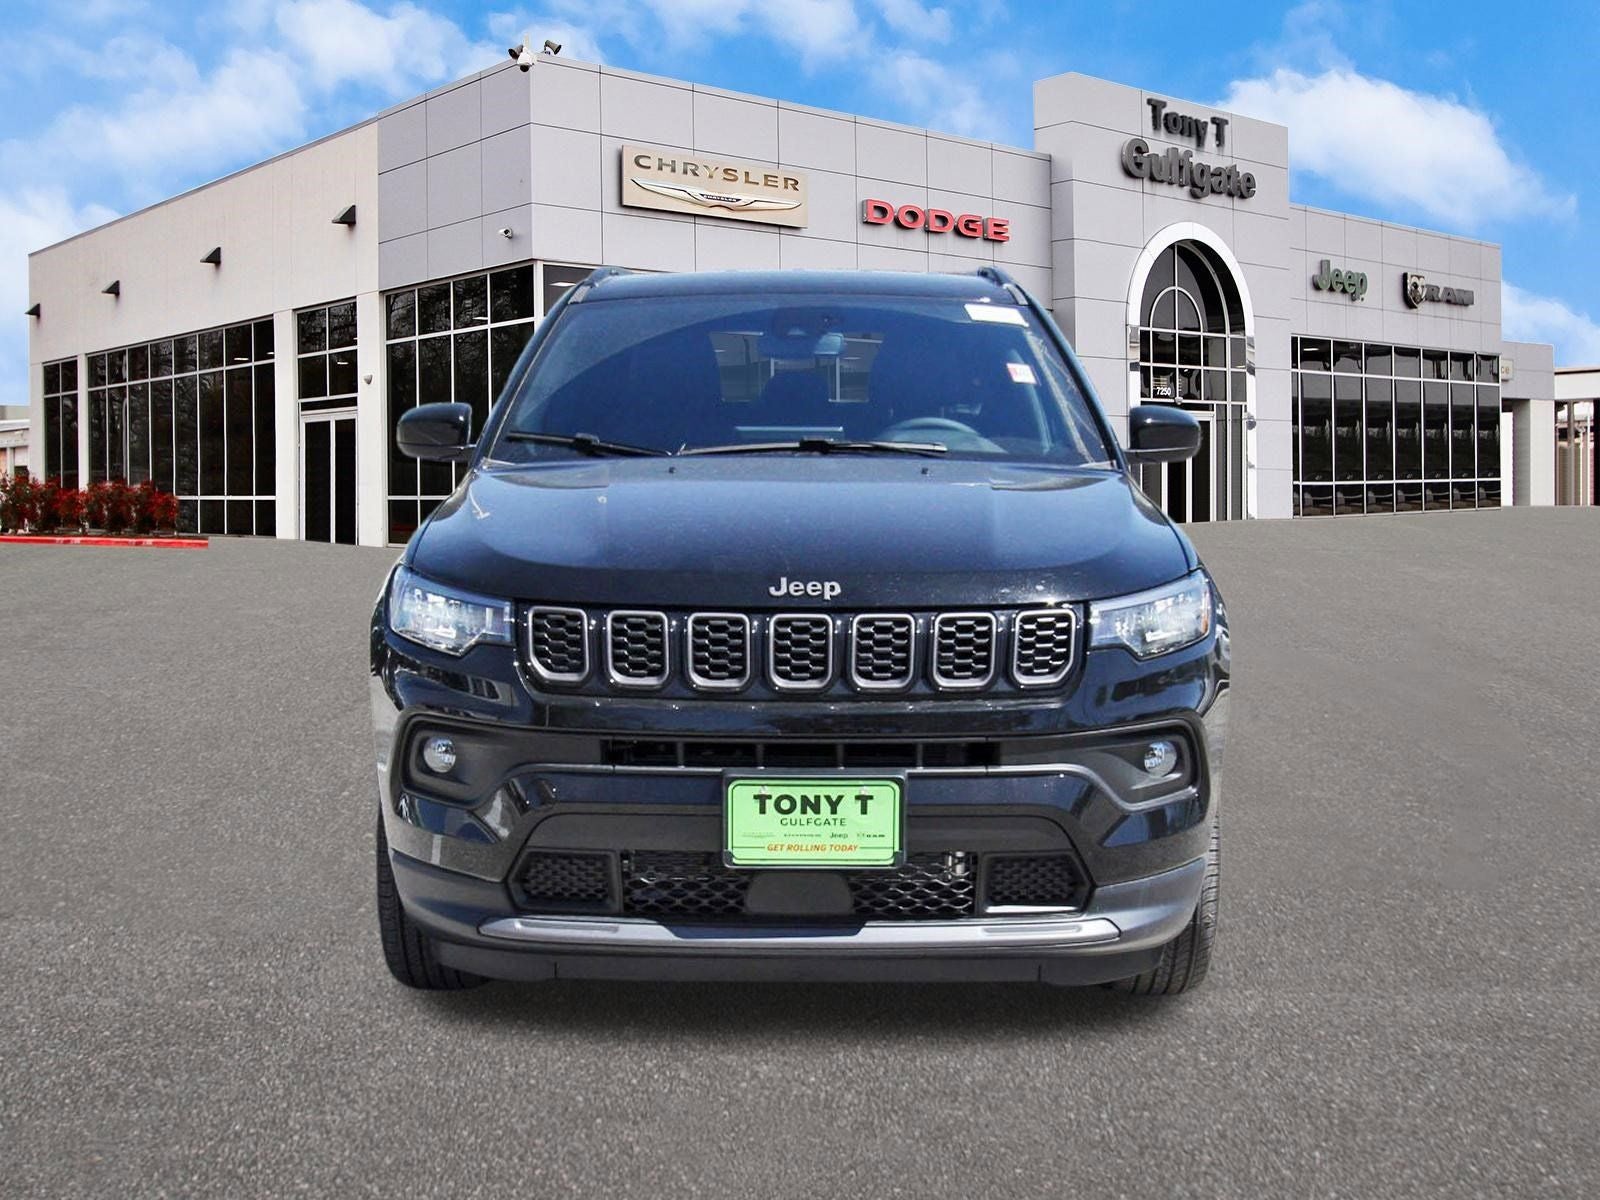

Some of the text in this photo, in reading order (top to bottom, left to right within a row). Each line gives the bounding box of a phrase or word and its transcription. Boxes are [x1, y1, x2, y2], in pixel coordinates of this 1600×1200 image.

[1146, 97, 1229, 148] Tony T
[633, 153, 801, 193] CHRYSLER
[1121, 138, 1257, 199] Gulfgate
[862, 198, 1011, 243] DODGE
[1312, 259, 1369, 301] Jeep
[1424, 284, 1475, 307] RAM
[1156, 386, 1172, 396] 7250
[769, 577, 841, 600] Jeep
[753, 794, 874, 815] TONY T
[780, 817, 847, 827] GULFGATE
[767, 844, 858, 852] GET ROLLING TODAY
